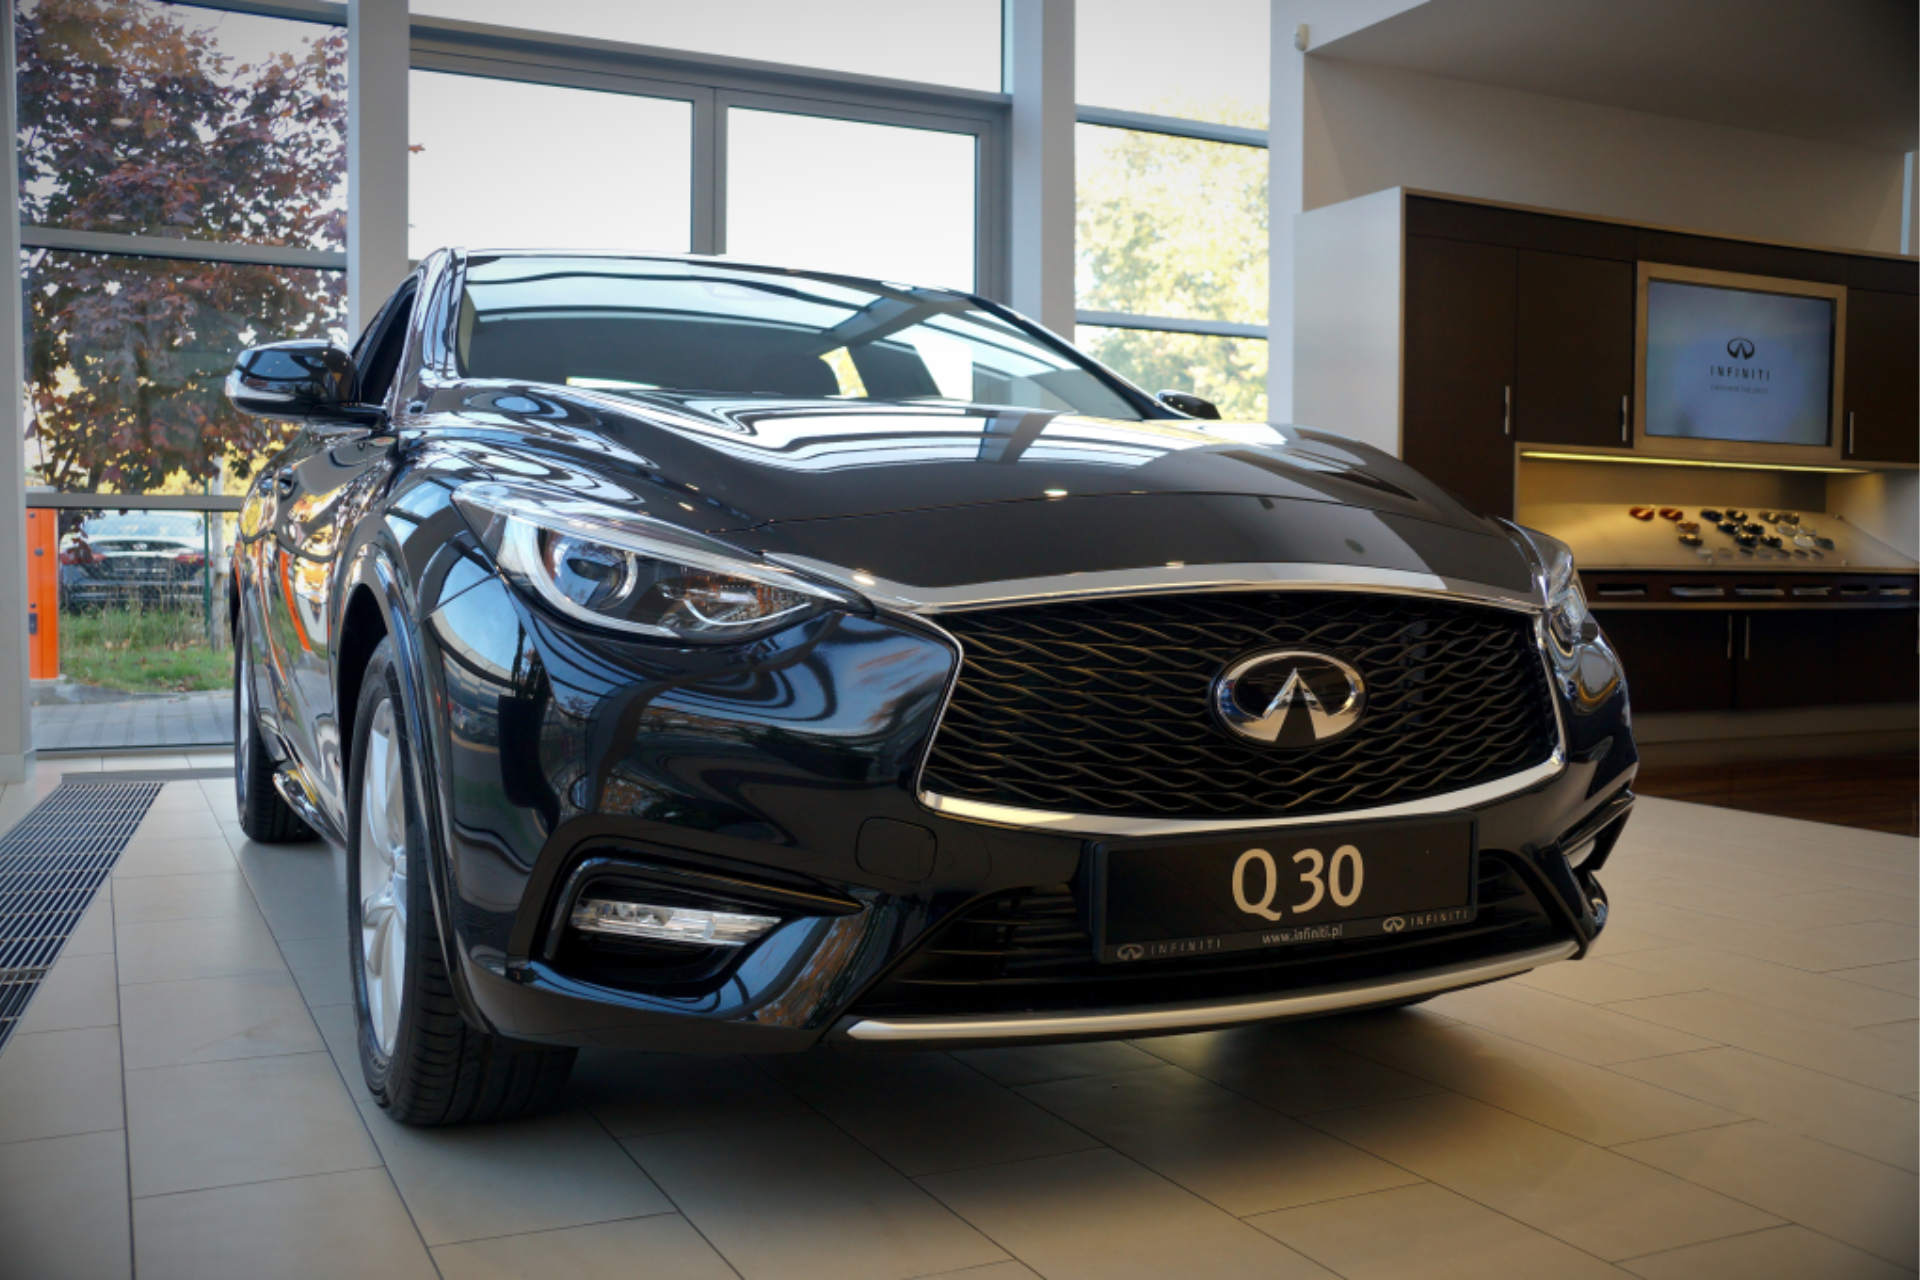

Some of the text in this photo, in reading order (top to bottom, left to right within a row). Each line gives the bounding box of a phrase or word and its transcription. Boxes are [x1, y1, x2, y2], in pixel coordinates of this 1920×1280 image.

[1710, 365, 1770, 381] INFINITI
[1231, 844, 1364, 922] Q 30
[1411, 909, 1467, 927] INFINITI
[1262, 924, 1343, 944] www.infiniti.pl
[1151, 938, 1221, 955] INFINITI
